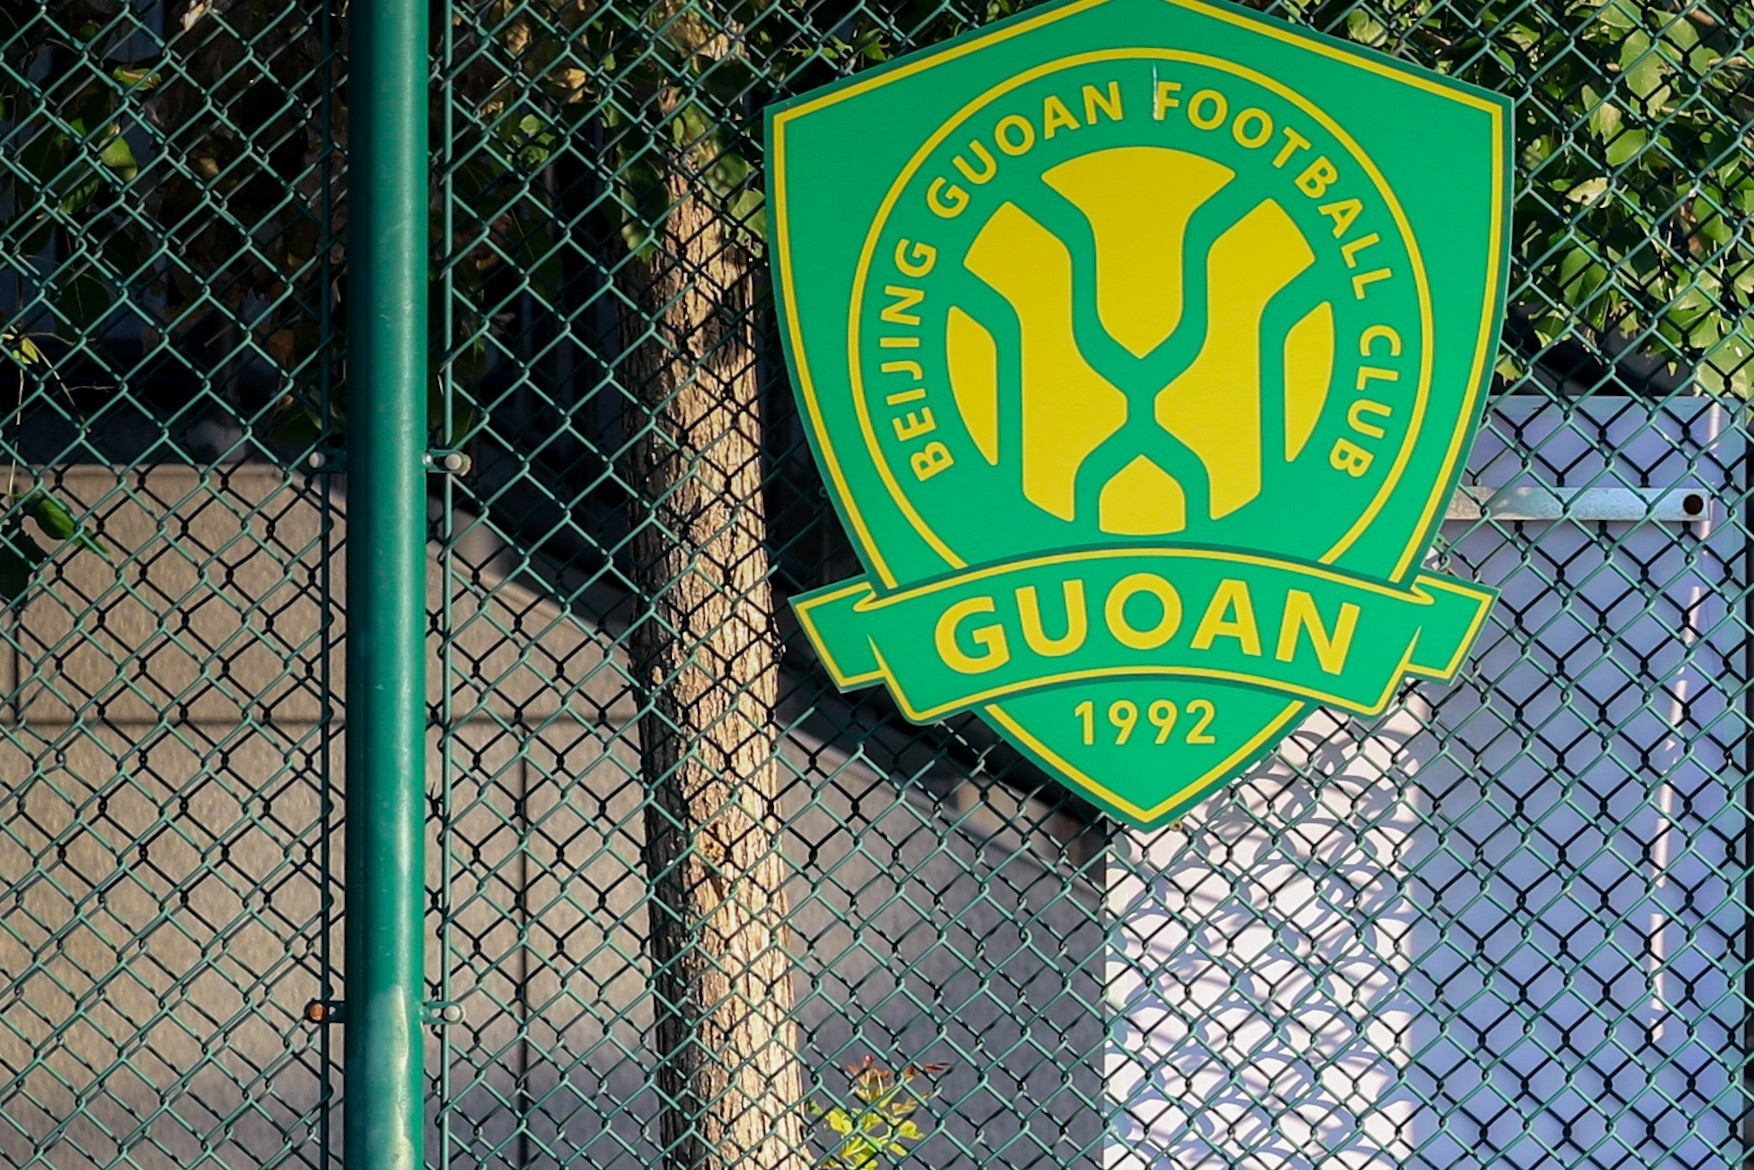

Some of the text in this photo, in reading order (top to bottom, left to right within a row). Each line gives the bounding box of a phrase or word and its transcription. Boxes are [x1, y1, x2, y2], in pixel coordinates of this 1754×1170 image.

[879, 81, 1402, 481] BEIJING GUOAN FOOTBALL CLUB
[934, 572, 1361, 675] GUOAN
[1074, 699, 1216, 745] 1992
